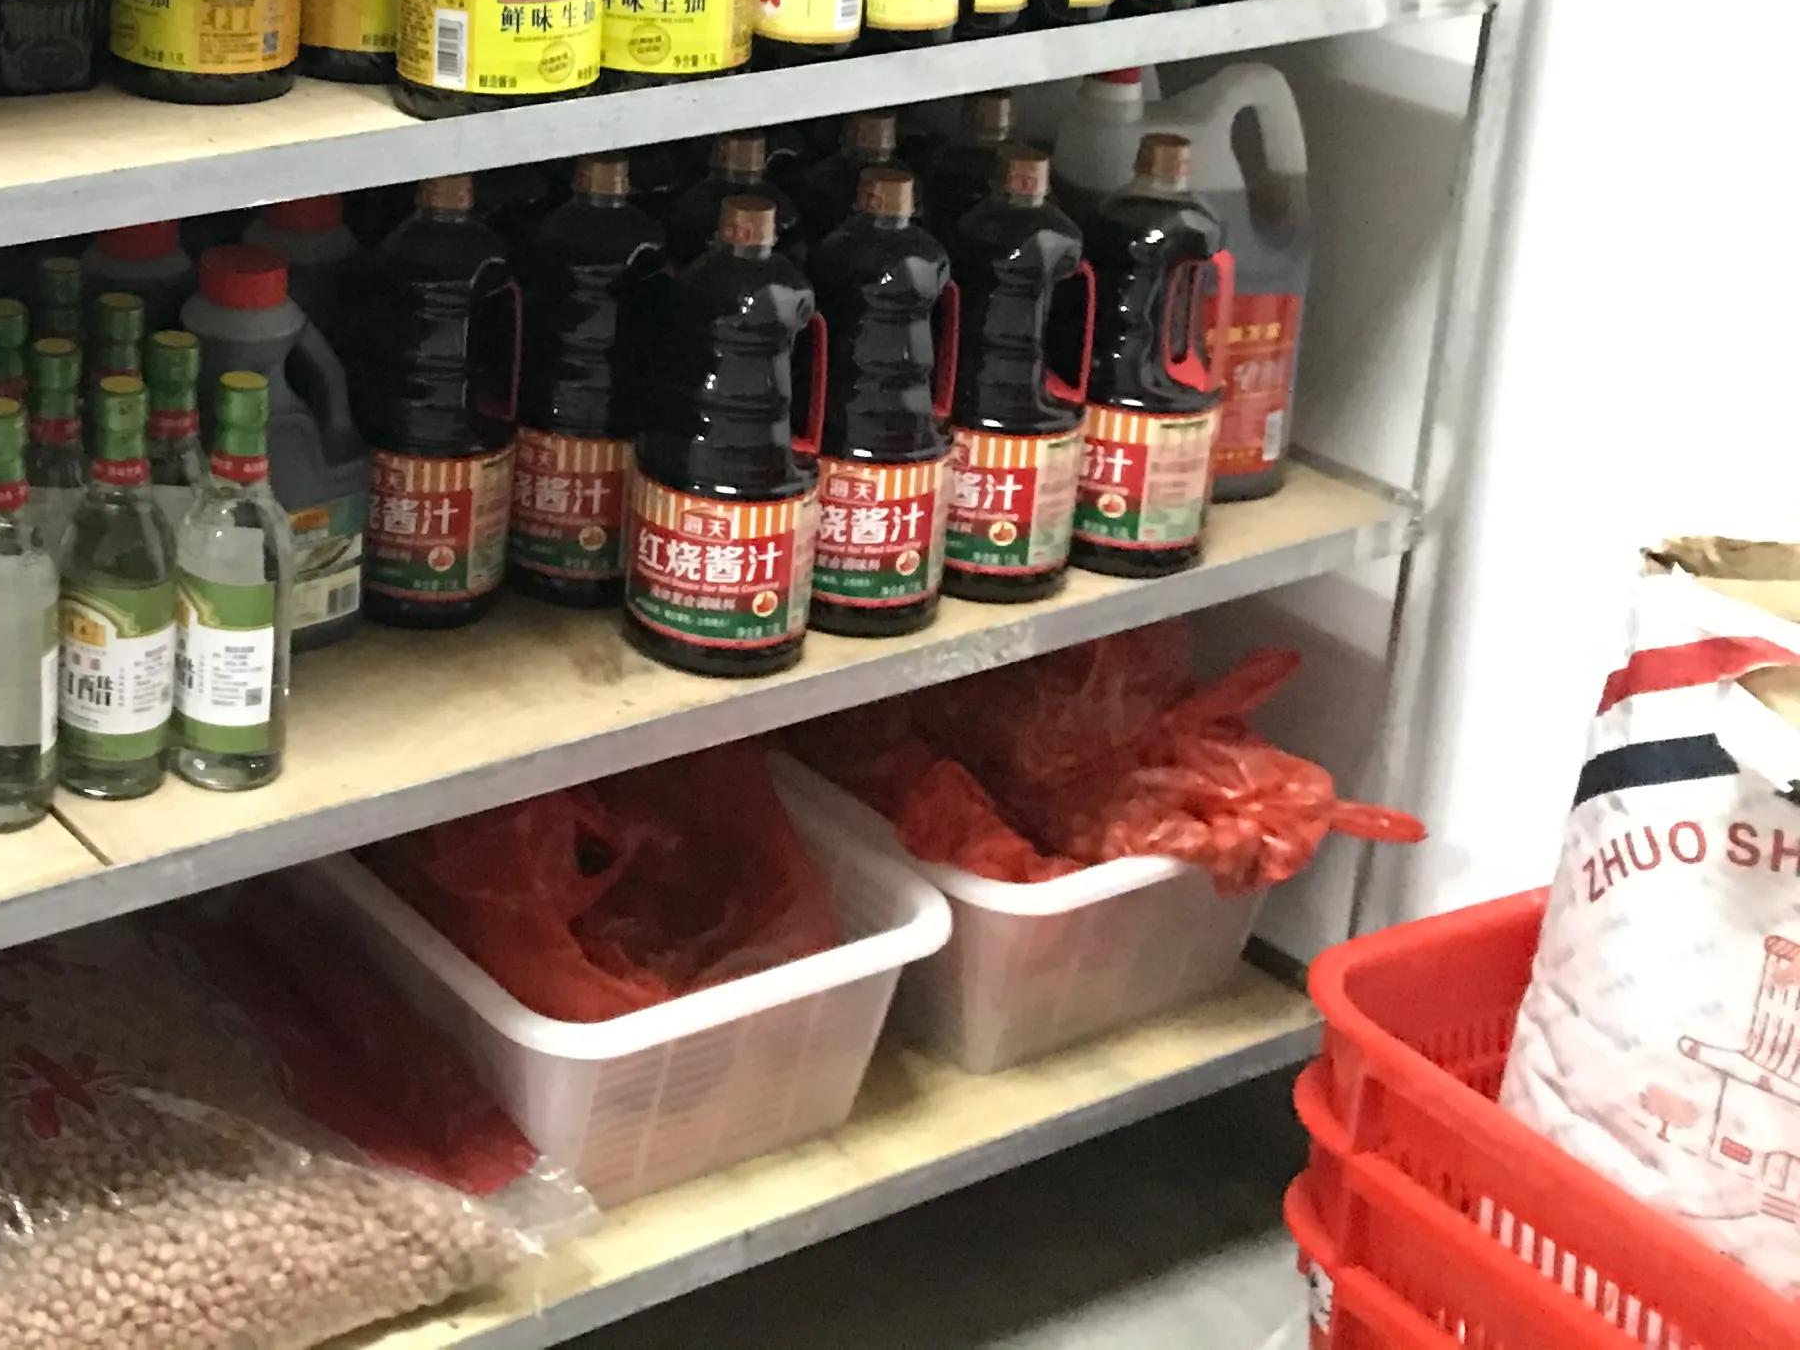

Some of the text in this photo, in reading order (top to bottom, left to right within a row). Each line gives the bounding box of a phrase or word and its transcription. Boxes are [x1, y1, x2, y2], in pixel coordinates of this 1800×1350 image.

[500, 1, 596, 34] 鲜味生抽
[829, 477, 873, 500] 海天
[954, 472, 1023, 510] 酱汁
[683, 514, 727, 539] 海天
[818, 502, 925, 544] 烧酱汁
[637, 527, 783, 584] 红烧酱汁
[1582, 820, 1800, 904] ZHUO SH
